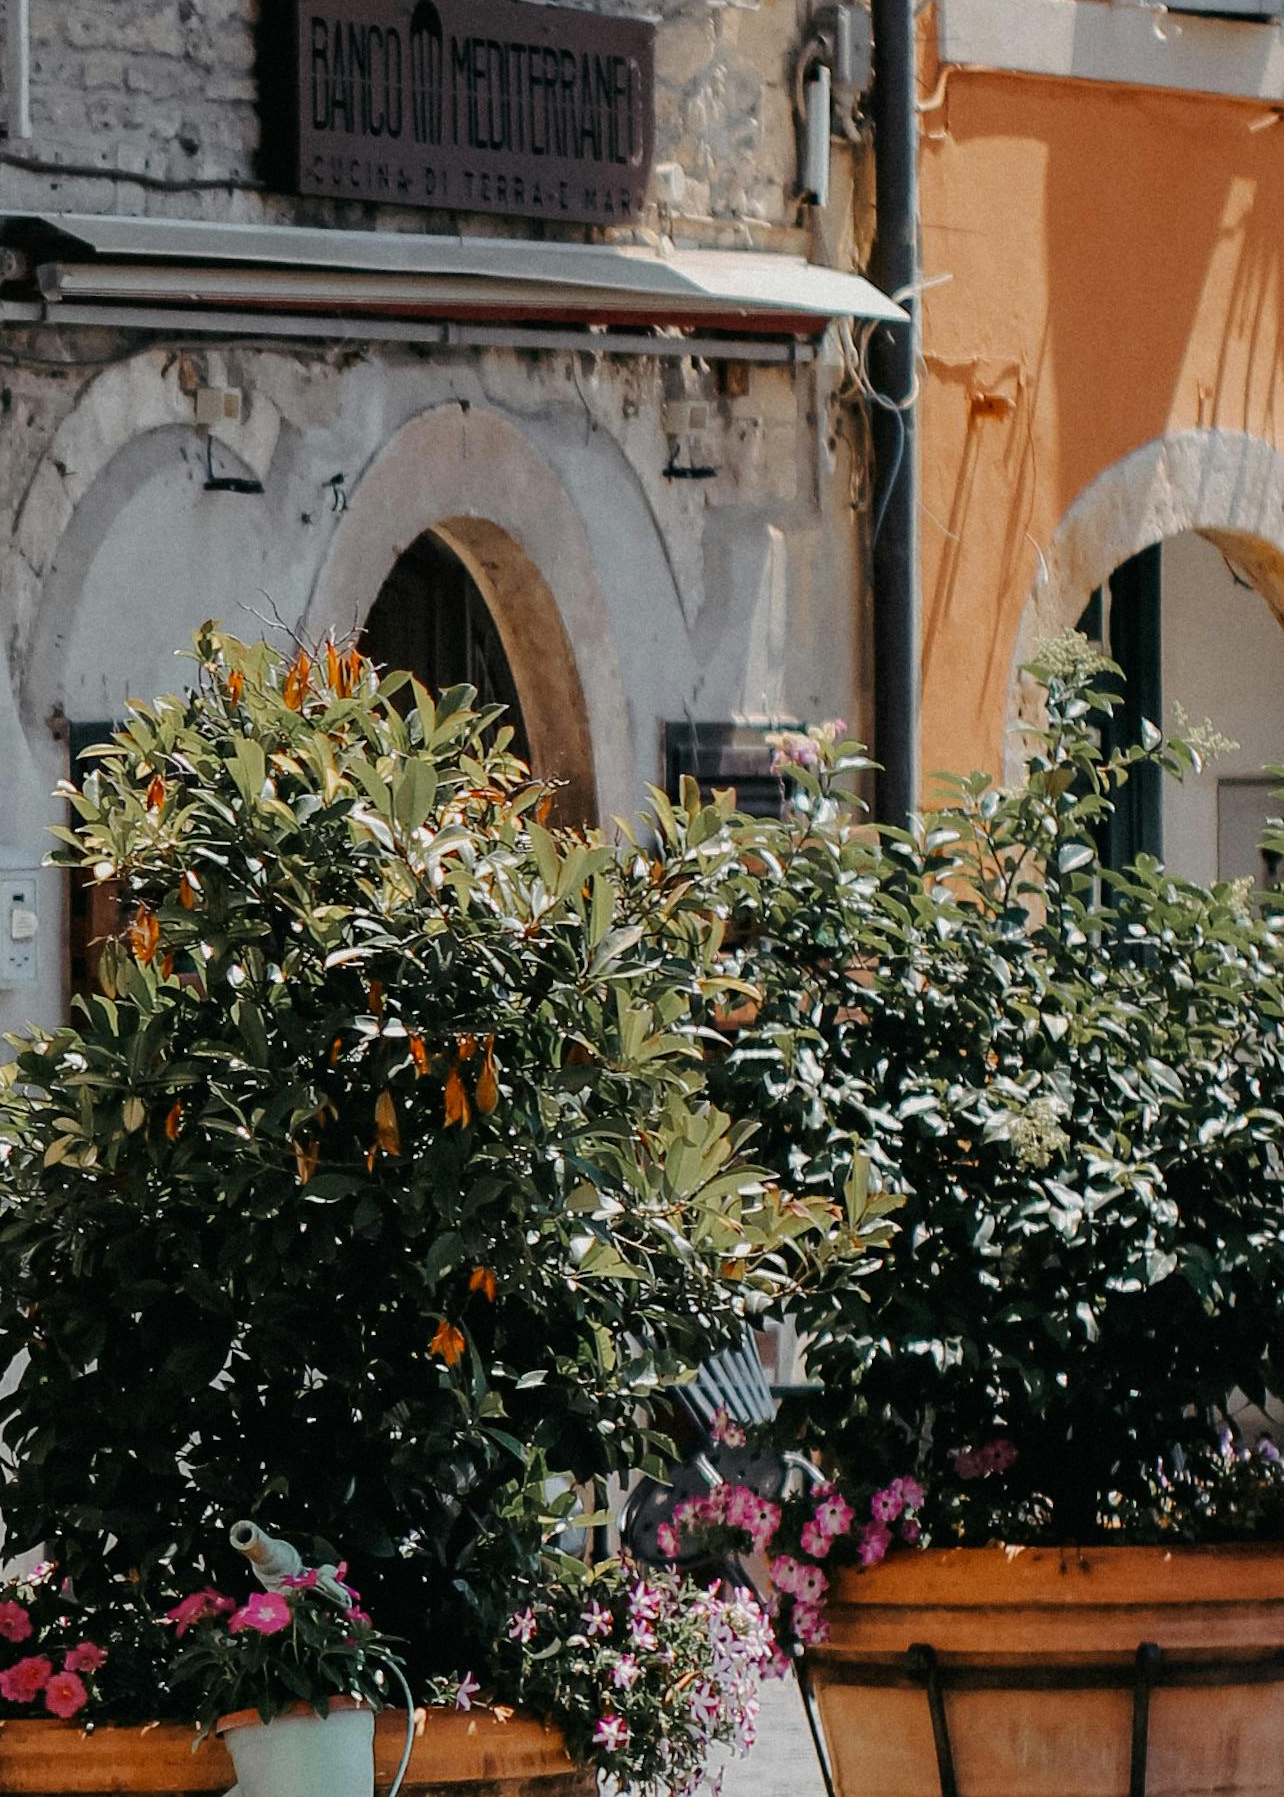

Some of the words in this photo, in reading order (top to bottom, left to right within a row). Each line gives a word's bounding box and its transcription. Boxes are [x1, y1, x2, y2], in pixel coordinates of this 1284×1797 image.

[311, 16, 403, 139] BANCO
[313, 155, 409, 196] CUCINA
[424, 165, 448, 196] DI
[463, 169, 544, 208] TERRA
[559, 180, 569, 211] E
